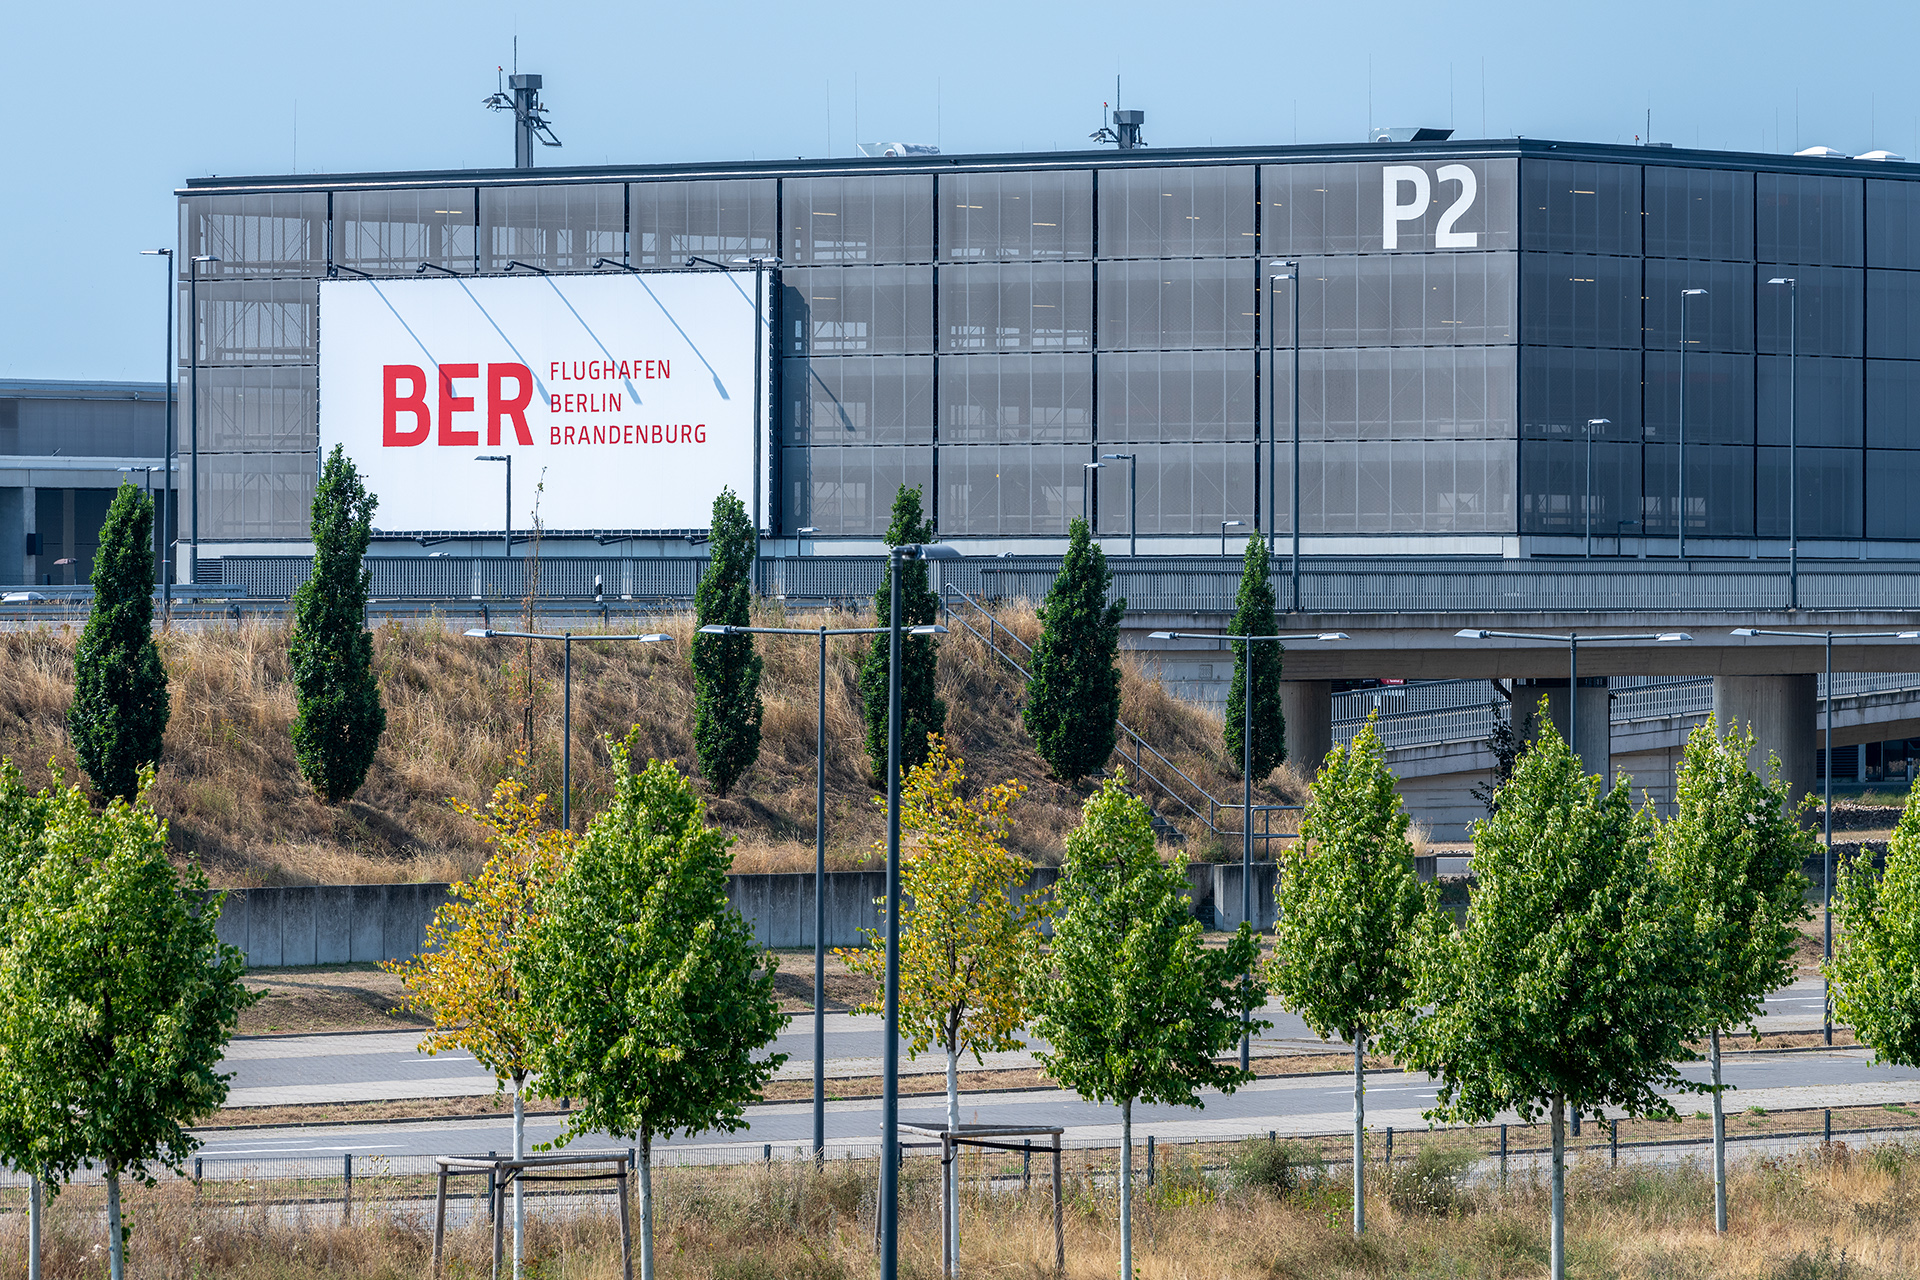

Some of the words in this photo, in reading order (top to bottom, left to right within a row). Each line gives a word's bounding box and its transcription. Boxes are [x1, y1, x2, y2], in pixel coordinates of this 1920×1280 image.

[1383, 164, 1477, 249] P2
[551, 360, 670, 380] FLUGHAFEN
[383, 363, 534, 447] BER
[551, 393, 621, 413] BERLIN
[551, 424, 706, 445] BRANDENBURG
